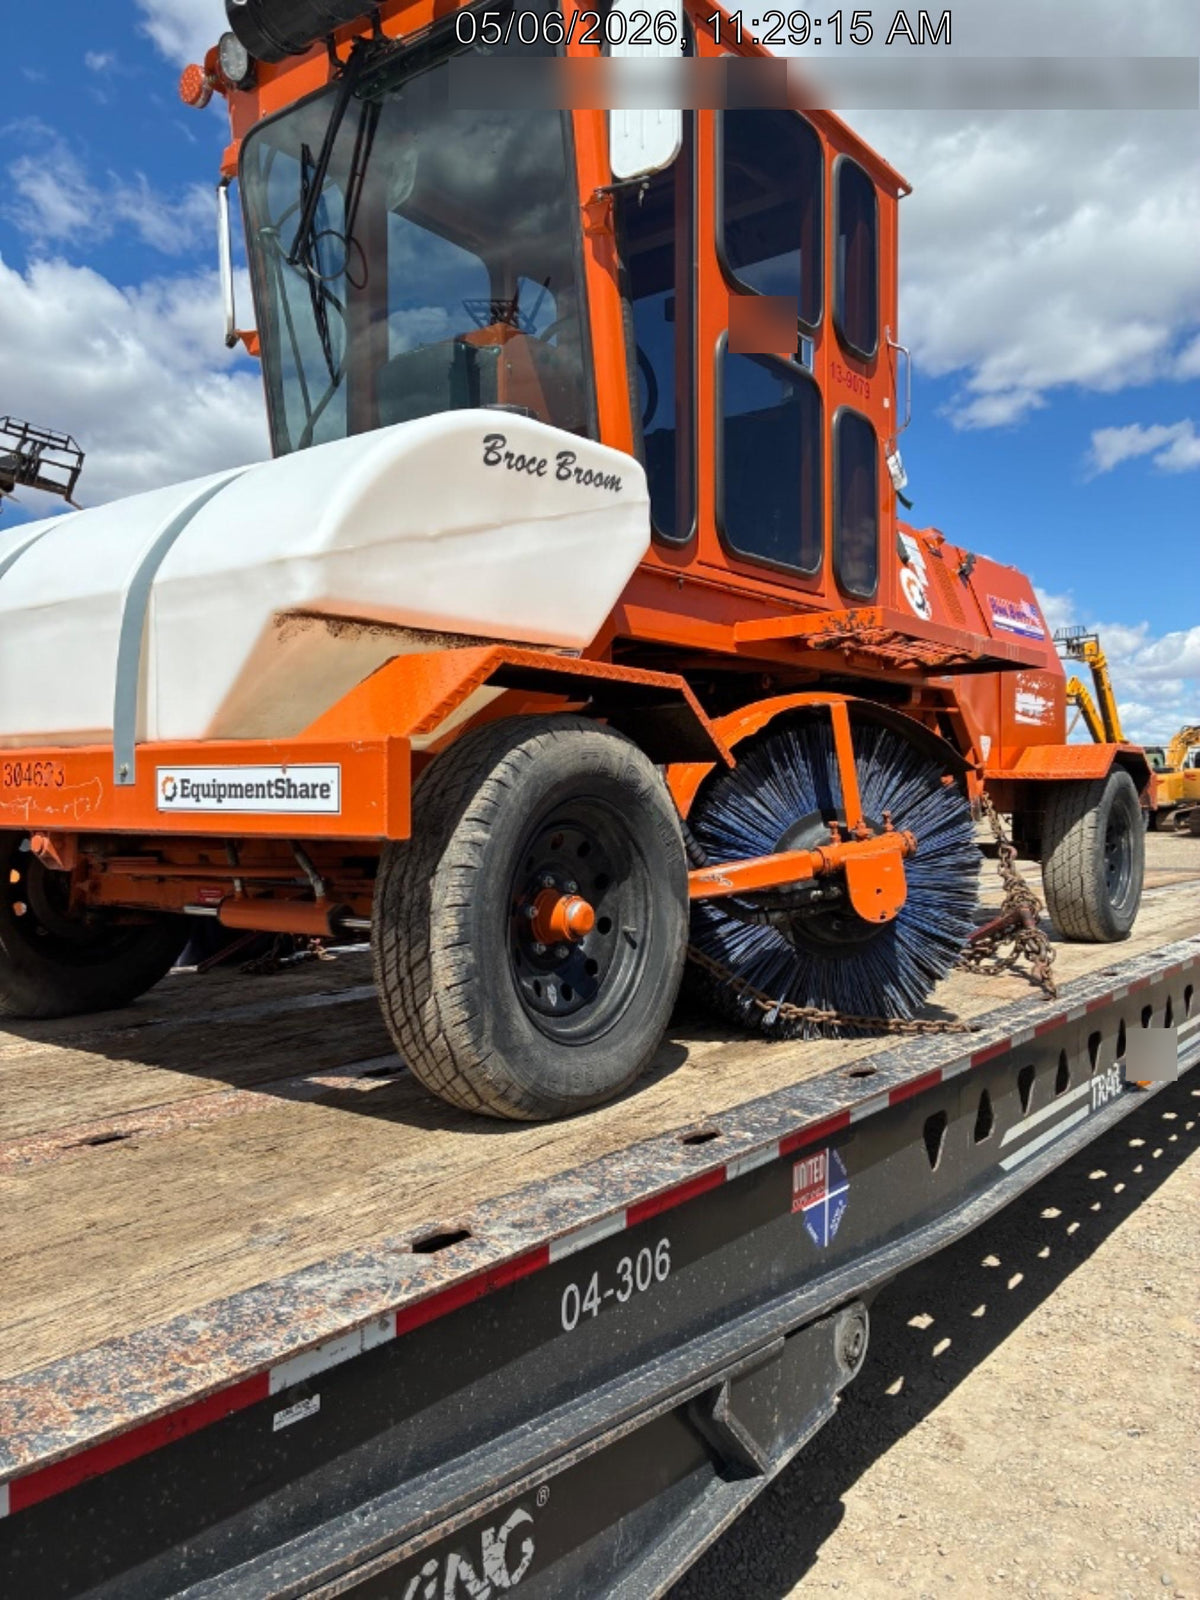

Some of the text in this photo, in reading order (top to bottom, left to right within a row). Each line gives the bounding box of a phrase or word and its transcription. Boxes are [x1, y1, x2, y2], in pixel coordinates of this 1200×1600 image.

[483, 433, 622, 492] Broce Broom
[180, 778, 331, 803] EquipmentShare
[561, 1237, 671, 1331] 04-306
